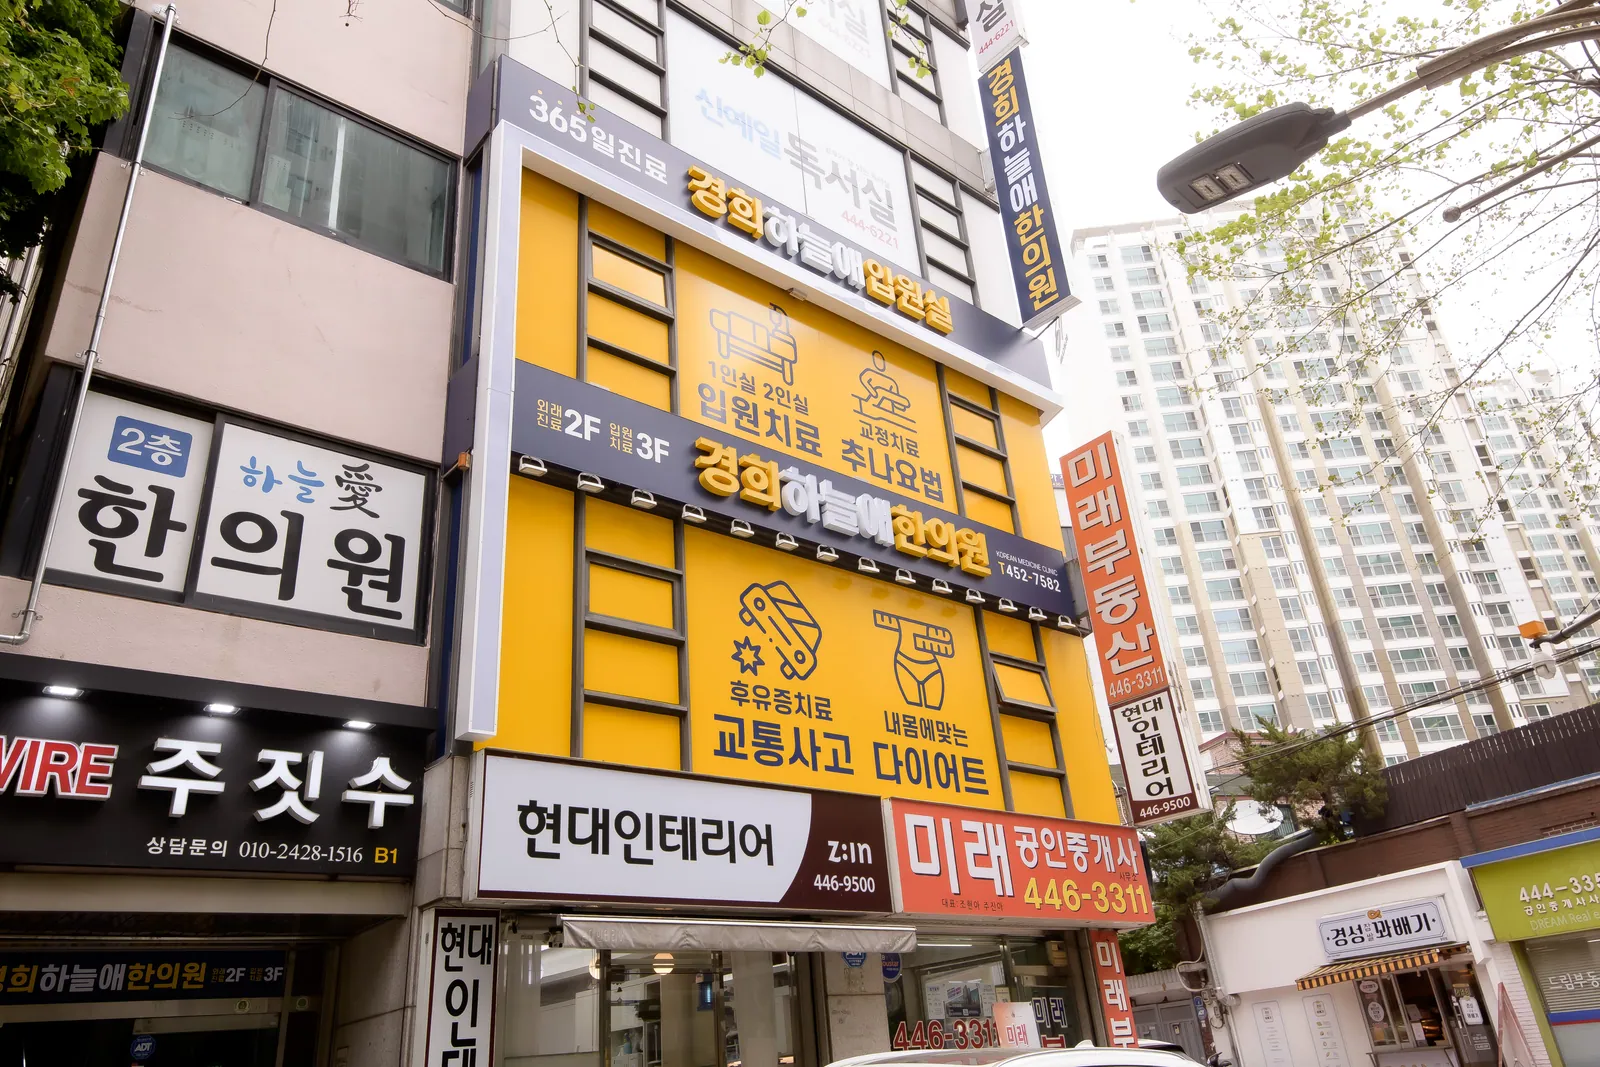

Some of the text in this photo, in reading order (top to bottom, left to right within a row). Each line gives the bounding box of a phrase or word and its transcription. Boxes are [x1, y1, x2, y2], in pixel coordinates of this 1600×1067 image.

[979, 20, 1015, 55] 444-6221
[783, 131, 898, 232] 독서실
[841, 209, 899, 250] 444-6221
[708, 361, 809, 416] 1인실 2인실
[536, 399, 562, 419] 외래
[536, 413, 562, 432] 진료
[564, 408, 601, 441] 2F
[697, 382, 823, 458] 입원치료
[116, 426, 183, 466] 2층
[609, 423, 633, 442] 입원
[610, 436, 633, 454] 치료
[636, 432, 670, 464] 3F
[859, 419, 920, 459] 교정치료
[841, 438, 944, 504] 추나요법
[77, 474, 406, 621] 한의원
[995, 550, 1058, 577] KOREAN MEDICINE CLINIC
[1067, 441, 1156, 678] 미래부동산
[1109, 666, 1165, 698] 446-3311
[730, 680, 833, 722] 후유증치료
[713, 713, 855, 776] 교통사고
[138, 736, 415, 829] 주짓수
[872, 741, 990, 796] 다이어트
[1139, 796, 1191, 818] 446-9500
[146, 837, 228, 859] 상담문의
[516, 799, 775, 867] 현대인테리어
[238, 840, 364, 863] 010-2428-1516
[374, 847, 399, 865] B1
[904, 812, 1015, 898] 미래
[1013, 825, 1140, 876] 공인중개사
[813, 873, 876, 894] 446-9500
[1023, 876, 1150, 915] 446-3311
[1330, 923, 1366, 947] 경성
[1530, 915, 1568, 932] DREAM
[1569, 910, 1592, 924] Real
[0, 962, 207, 993] 희하늘애한의원
[225, 967, 246, 983] 2F
[263, 966, 284, 982] 3F
[1032, 997, 1068, 1028] 미래
[134, 1042, 153, 1053] ADT
[1006, 1023, 1029, 1047] 미래
